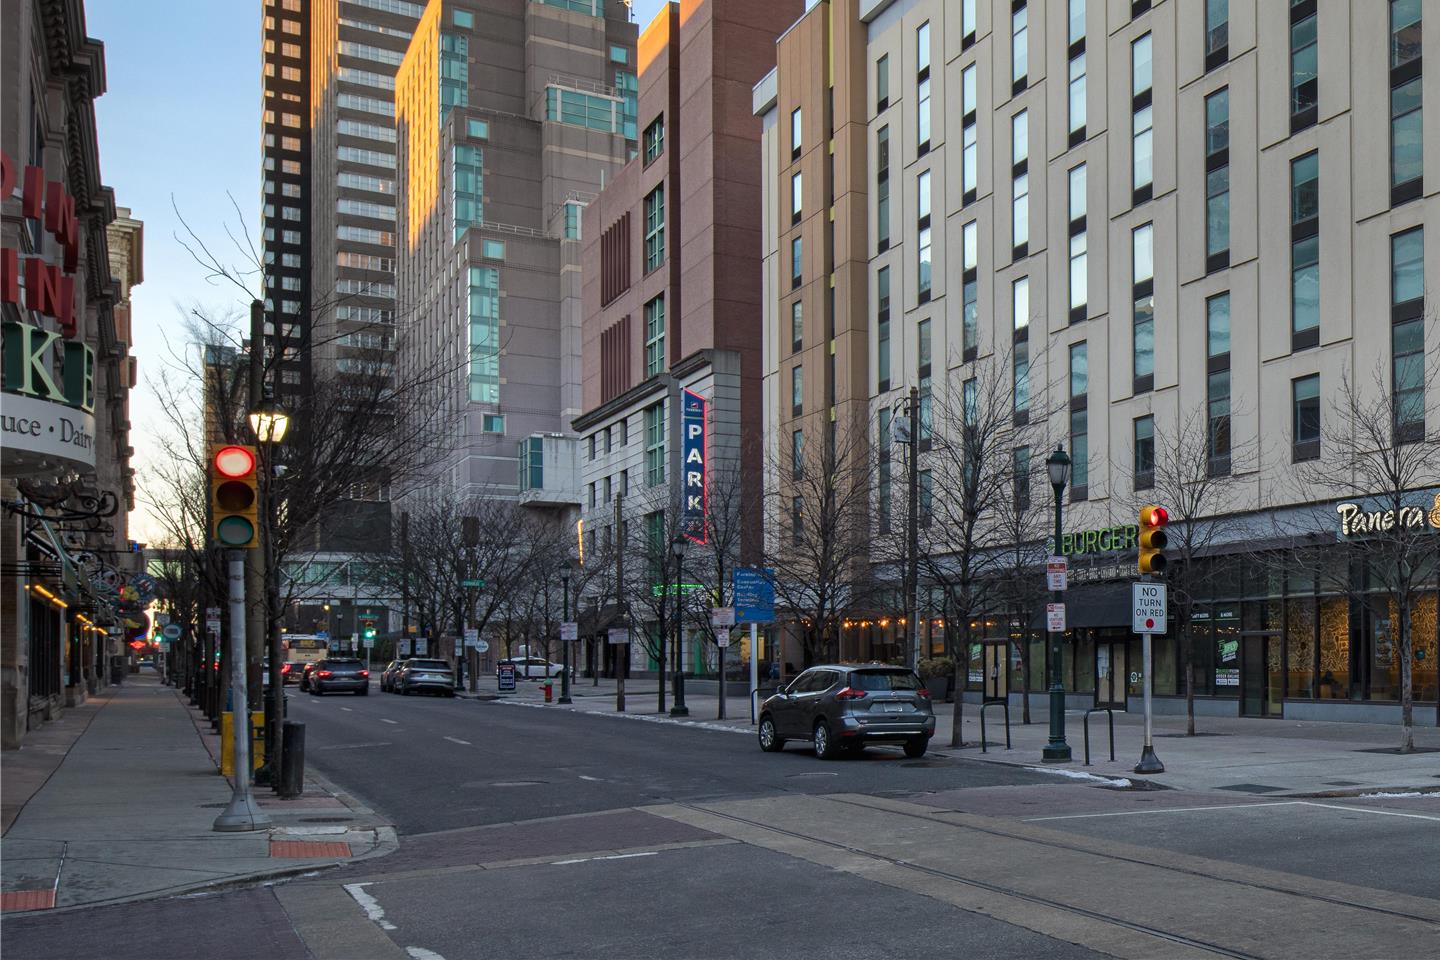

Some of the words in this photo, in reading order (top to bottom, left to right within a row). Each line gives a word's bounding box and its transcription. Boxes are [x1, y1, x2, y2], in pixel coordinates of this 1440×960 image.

[60, 417, 94, 451] Dairy
[686, 424, 703, 511] PARK
[1336, 503, 1425, 537] Panera
[1062, 524, 1138, 556] BURGER
[1138, 598, 1162, 607] TURN
[1142, 587, 1158, 597] NO
[1136, 608, 1148, 617] ON
[1149, 608, 1165, 617] RED
